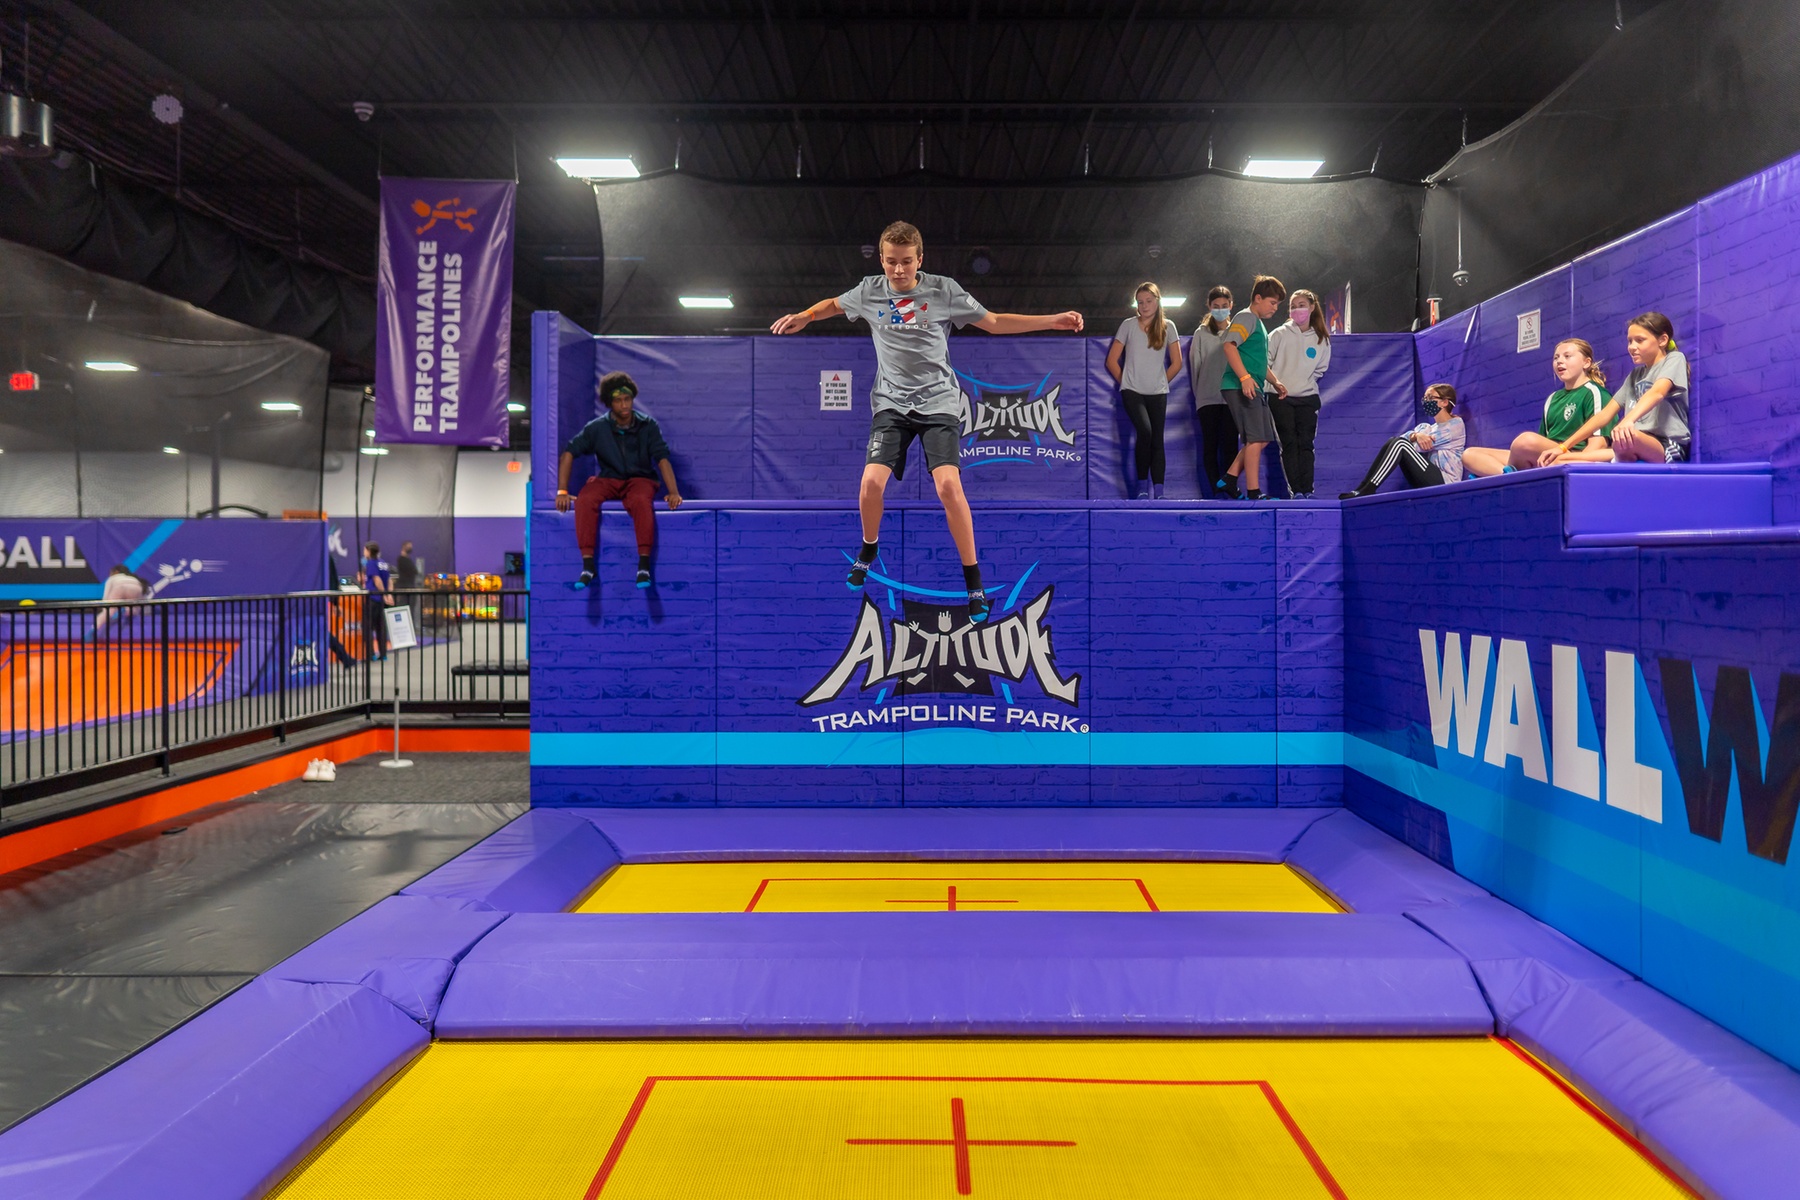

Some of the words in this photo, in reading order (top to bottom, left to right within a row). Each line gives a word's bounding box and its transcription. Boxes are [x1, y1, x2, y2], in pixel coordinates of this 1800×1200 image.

[413, 240, 438, 432] PERFORMANCE
[439, 252, 463, 434] TRAMPOLINES
[0, 535, 87, 569] ALL
[799, 586, 1080, 706] ALTITUDE
[812, 705, 996, 733] TRAMPOLINE
[1418, 628, 1663, 824] WALL
